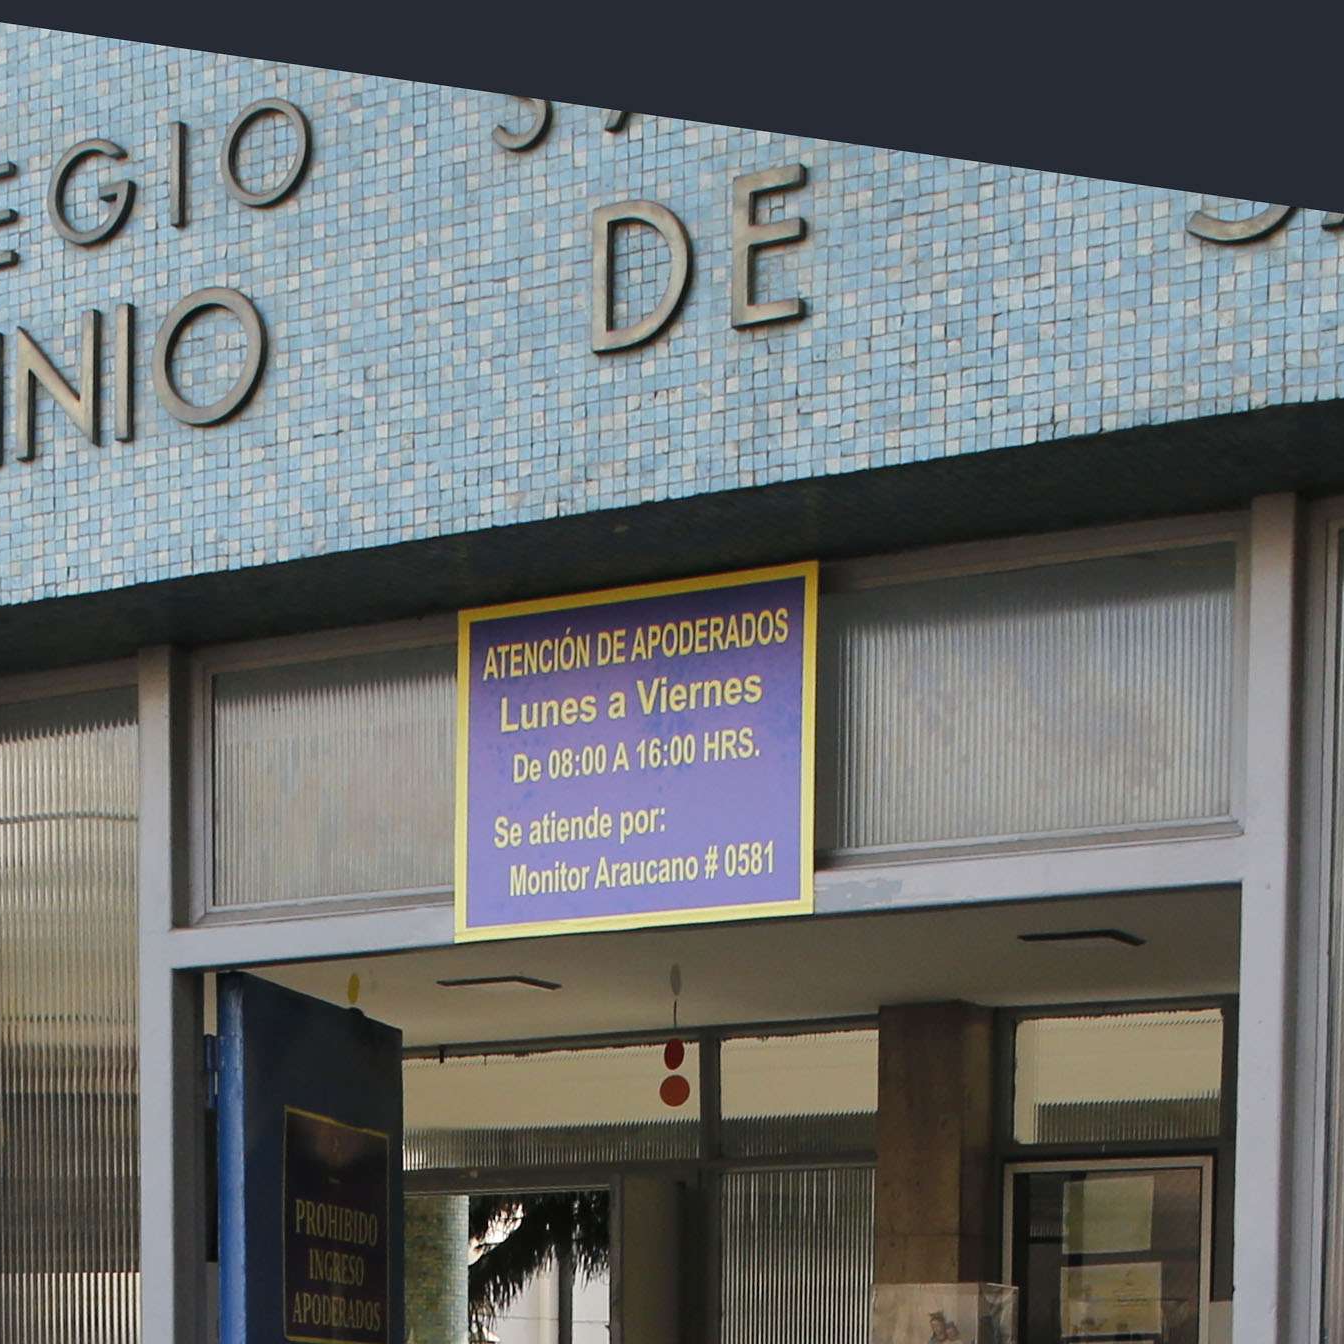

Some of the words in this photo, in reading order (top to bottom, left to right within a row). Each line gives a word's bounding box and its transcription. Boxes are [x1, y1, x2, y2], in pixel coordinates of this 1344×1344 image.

[592, 163, 808, 356] DE
[483, 627, 590, 681] ATENCIÓN
[597, 629, 627, 666] DE
[631, 608, 789, 661] APODERADOS
[500, 695, 597, 733] Lunes
[608, 692, 626, 718] a
[637, 675, 763, 714] Viernes
[513, 753, 541, 784] De
[549, 747, 606, 779] 08:00
[612, 742, 629, 772] A
[637, 735, 696, 769] 16:00
[703, 728, 761, 762] HRS.
[494, 816, 522, 849] Se
[529, 807, 612, 843] atiende
[620, 807, 665, 844] por:
[509, 862, 591, 896] Monitor
[594, 854, 699, 890] Araucano
[704, 845, 718, 879] #
[724, 841, 775, 877] 0581
[295, 1199, 378, 1247] PROHIBIDO
[309, 1247, 364, 1287] INGRESO
[292, 1291, 381, 1331] APODERADOS
